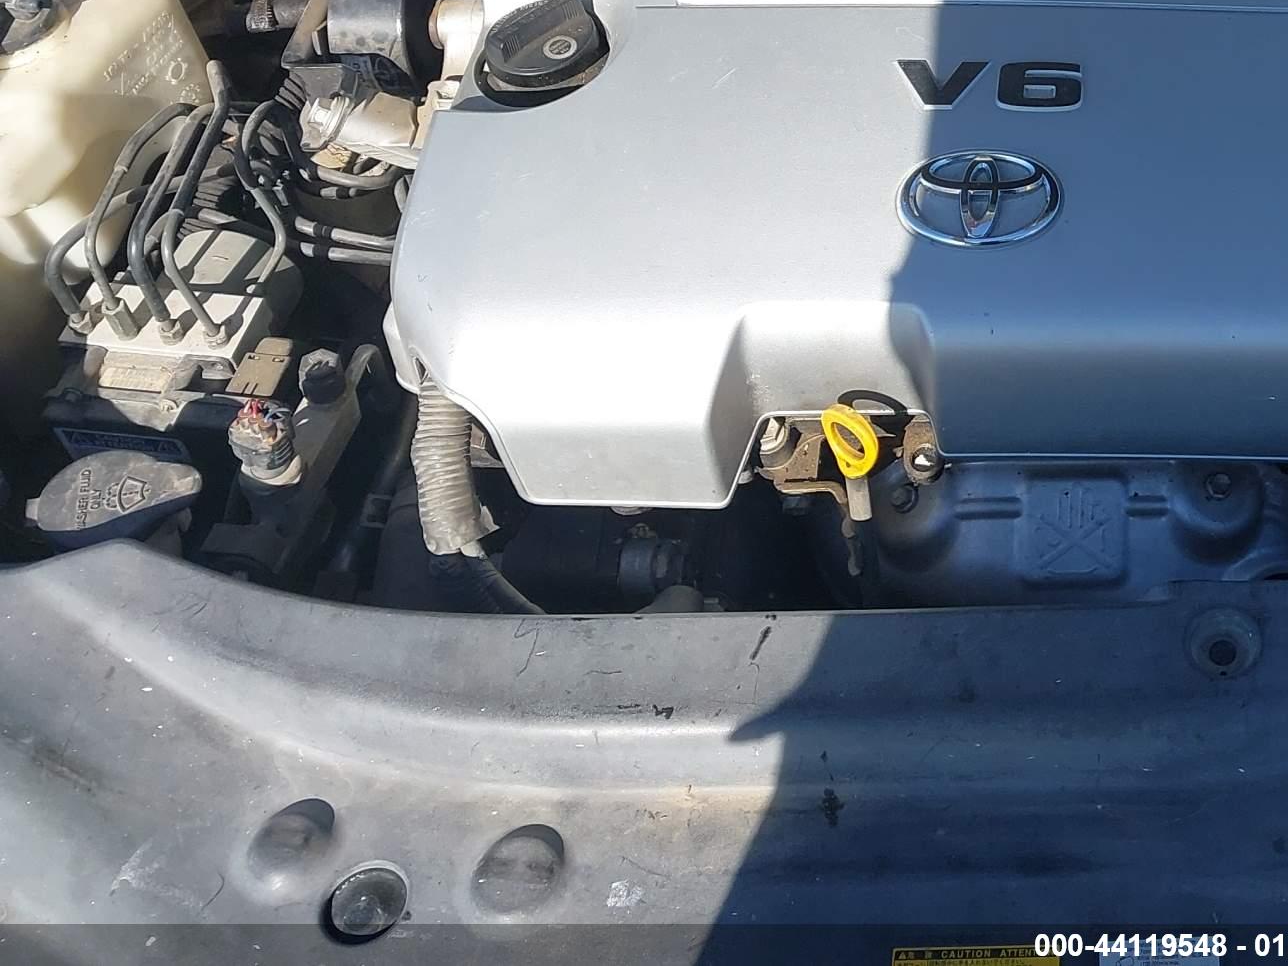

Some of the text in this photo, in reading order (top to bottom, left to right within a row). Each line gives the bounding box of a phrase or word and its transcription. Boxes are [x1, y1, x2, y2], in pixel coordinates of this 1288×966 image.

[895, 59, 1083, 111] V6
[79, 468, 93, 493] FLUID
[89, 489, 102, 511] ONLY
[940, 949, 992, 958] CAUTION
[999, 948, 1038, 957] ATTENT
